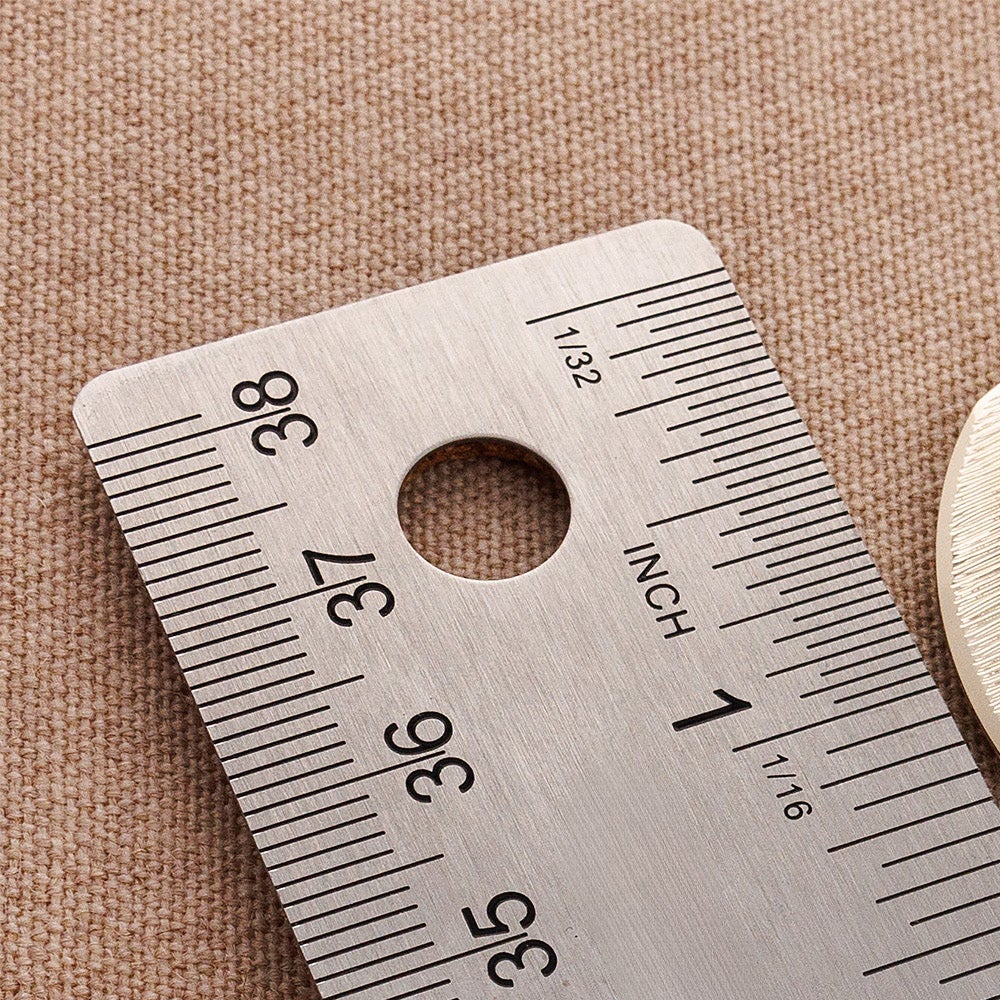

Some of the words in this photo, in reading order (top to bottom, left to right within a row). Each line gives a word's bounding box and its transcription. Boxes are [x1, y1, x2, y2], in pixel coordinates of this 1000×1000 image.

[553, 326, 602, 389] 1/32
[231, 369, 319, 457] 38
[301, 549, 396, 628] 37
[623, 542, 696, 640] INCH
[672, 688, 753, 732] 1
[384, 710, 475, 803] 36
[762, 753, 813, 821] 1/16
[461, 891, 558, 988] 35
